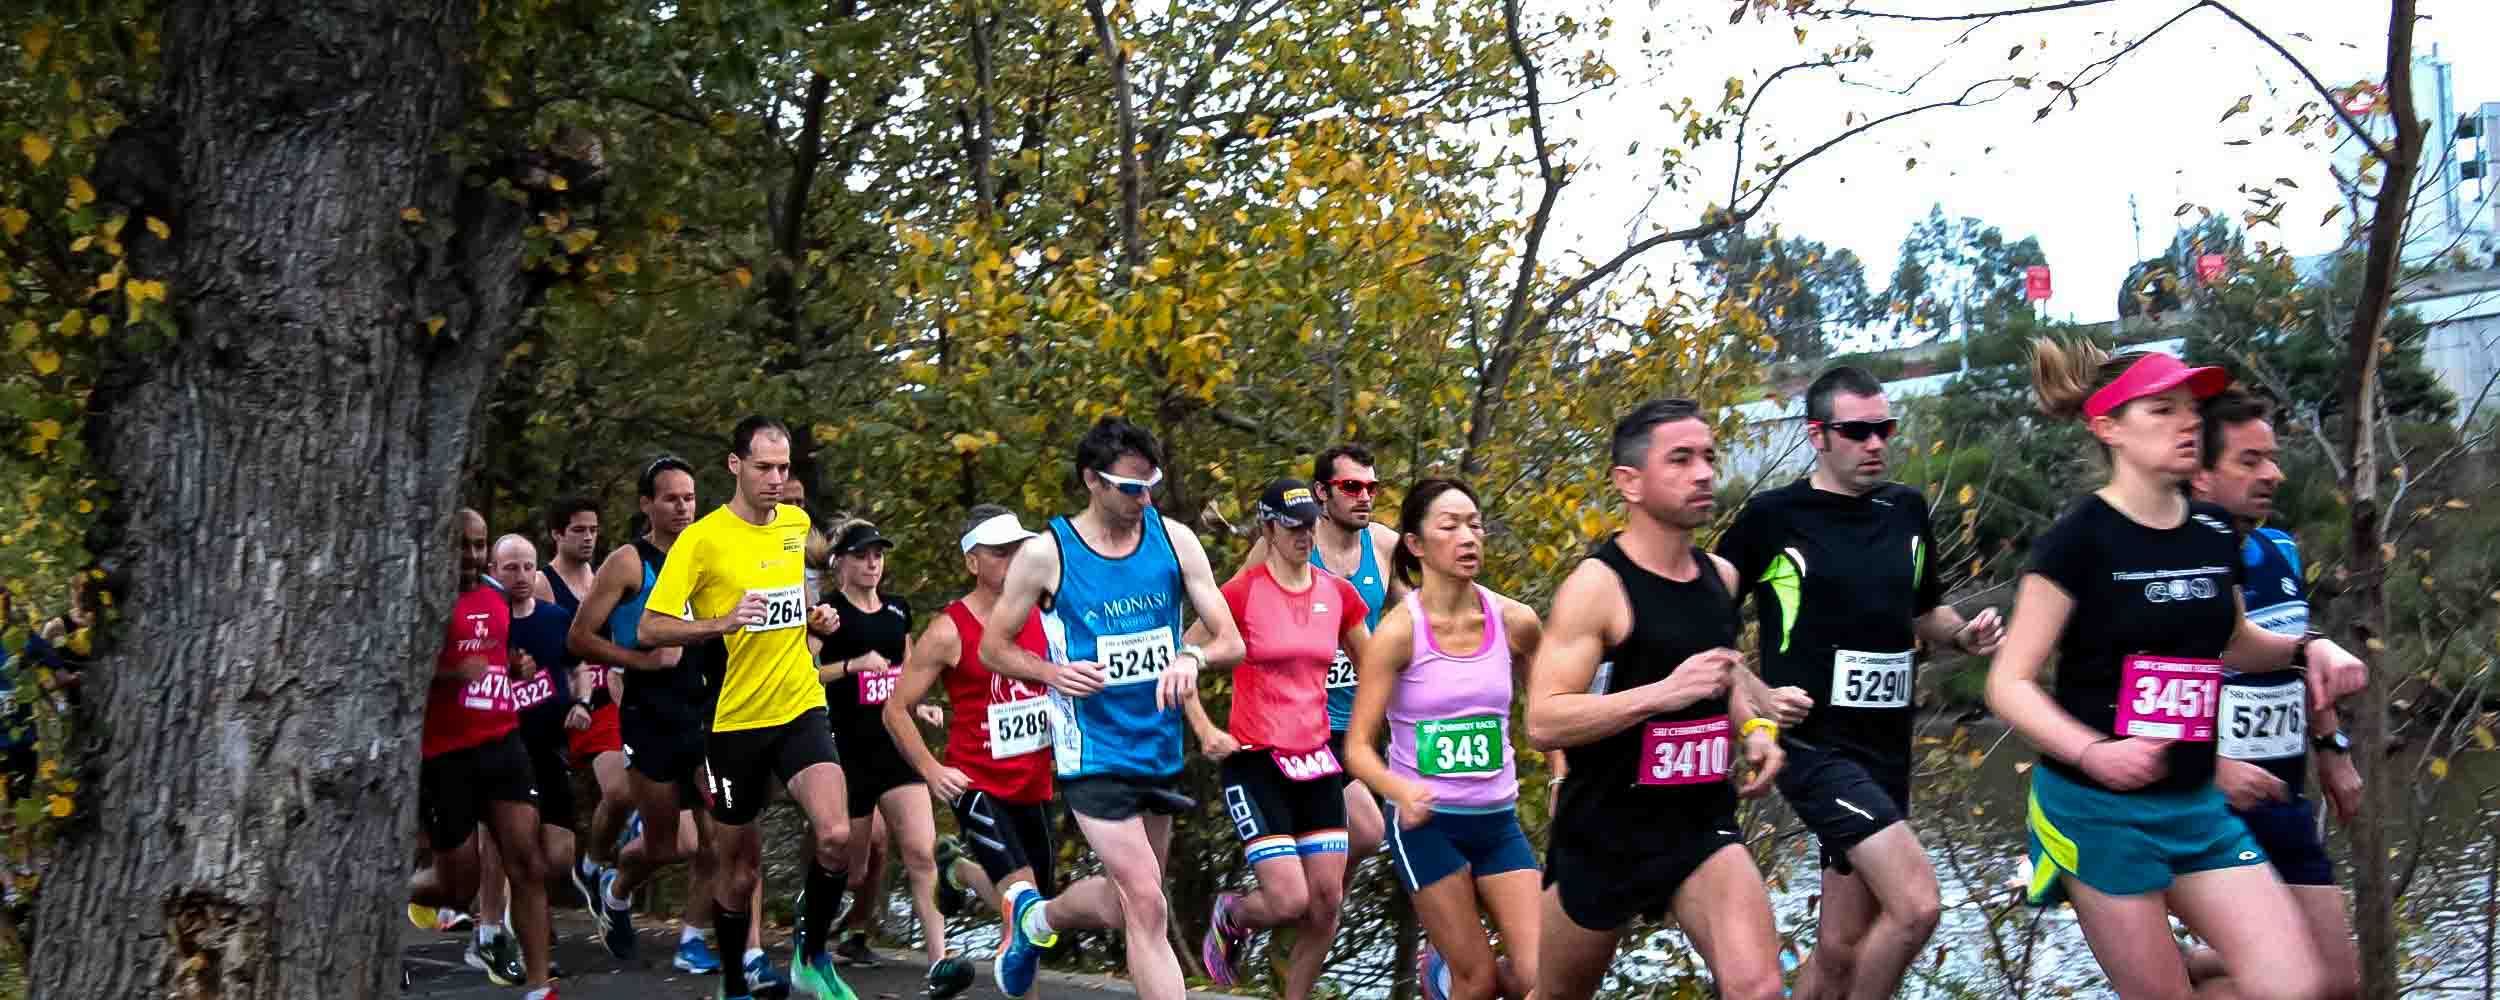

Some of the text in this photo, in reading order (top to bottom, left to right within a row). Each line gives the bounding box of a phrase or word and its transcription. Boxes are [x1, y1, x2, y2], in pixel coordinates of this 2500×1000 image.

[765, 598, 802, 625] 264
[1109, 645, 1169, 679] 5243
[1328, 661, 1357, 685] 52
[866, 677, 896, 701] 335
[1845, 669, 1905, 702] 5290
[2132, 676, 2218, 718] 3451
[999, 710, 1048, 741] 5289
[2232, 701, 2299, 738] 5276
[1436, 733, 1490, 770] 343
[1652, 736, 1729, 779] 3410
